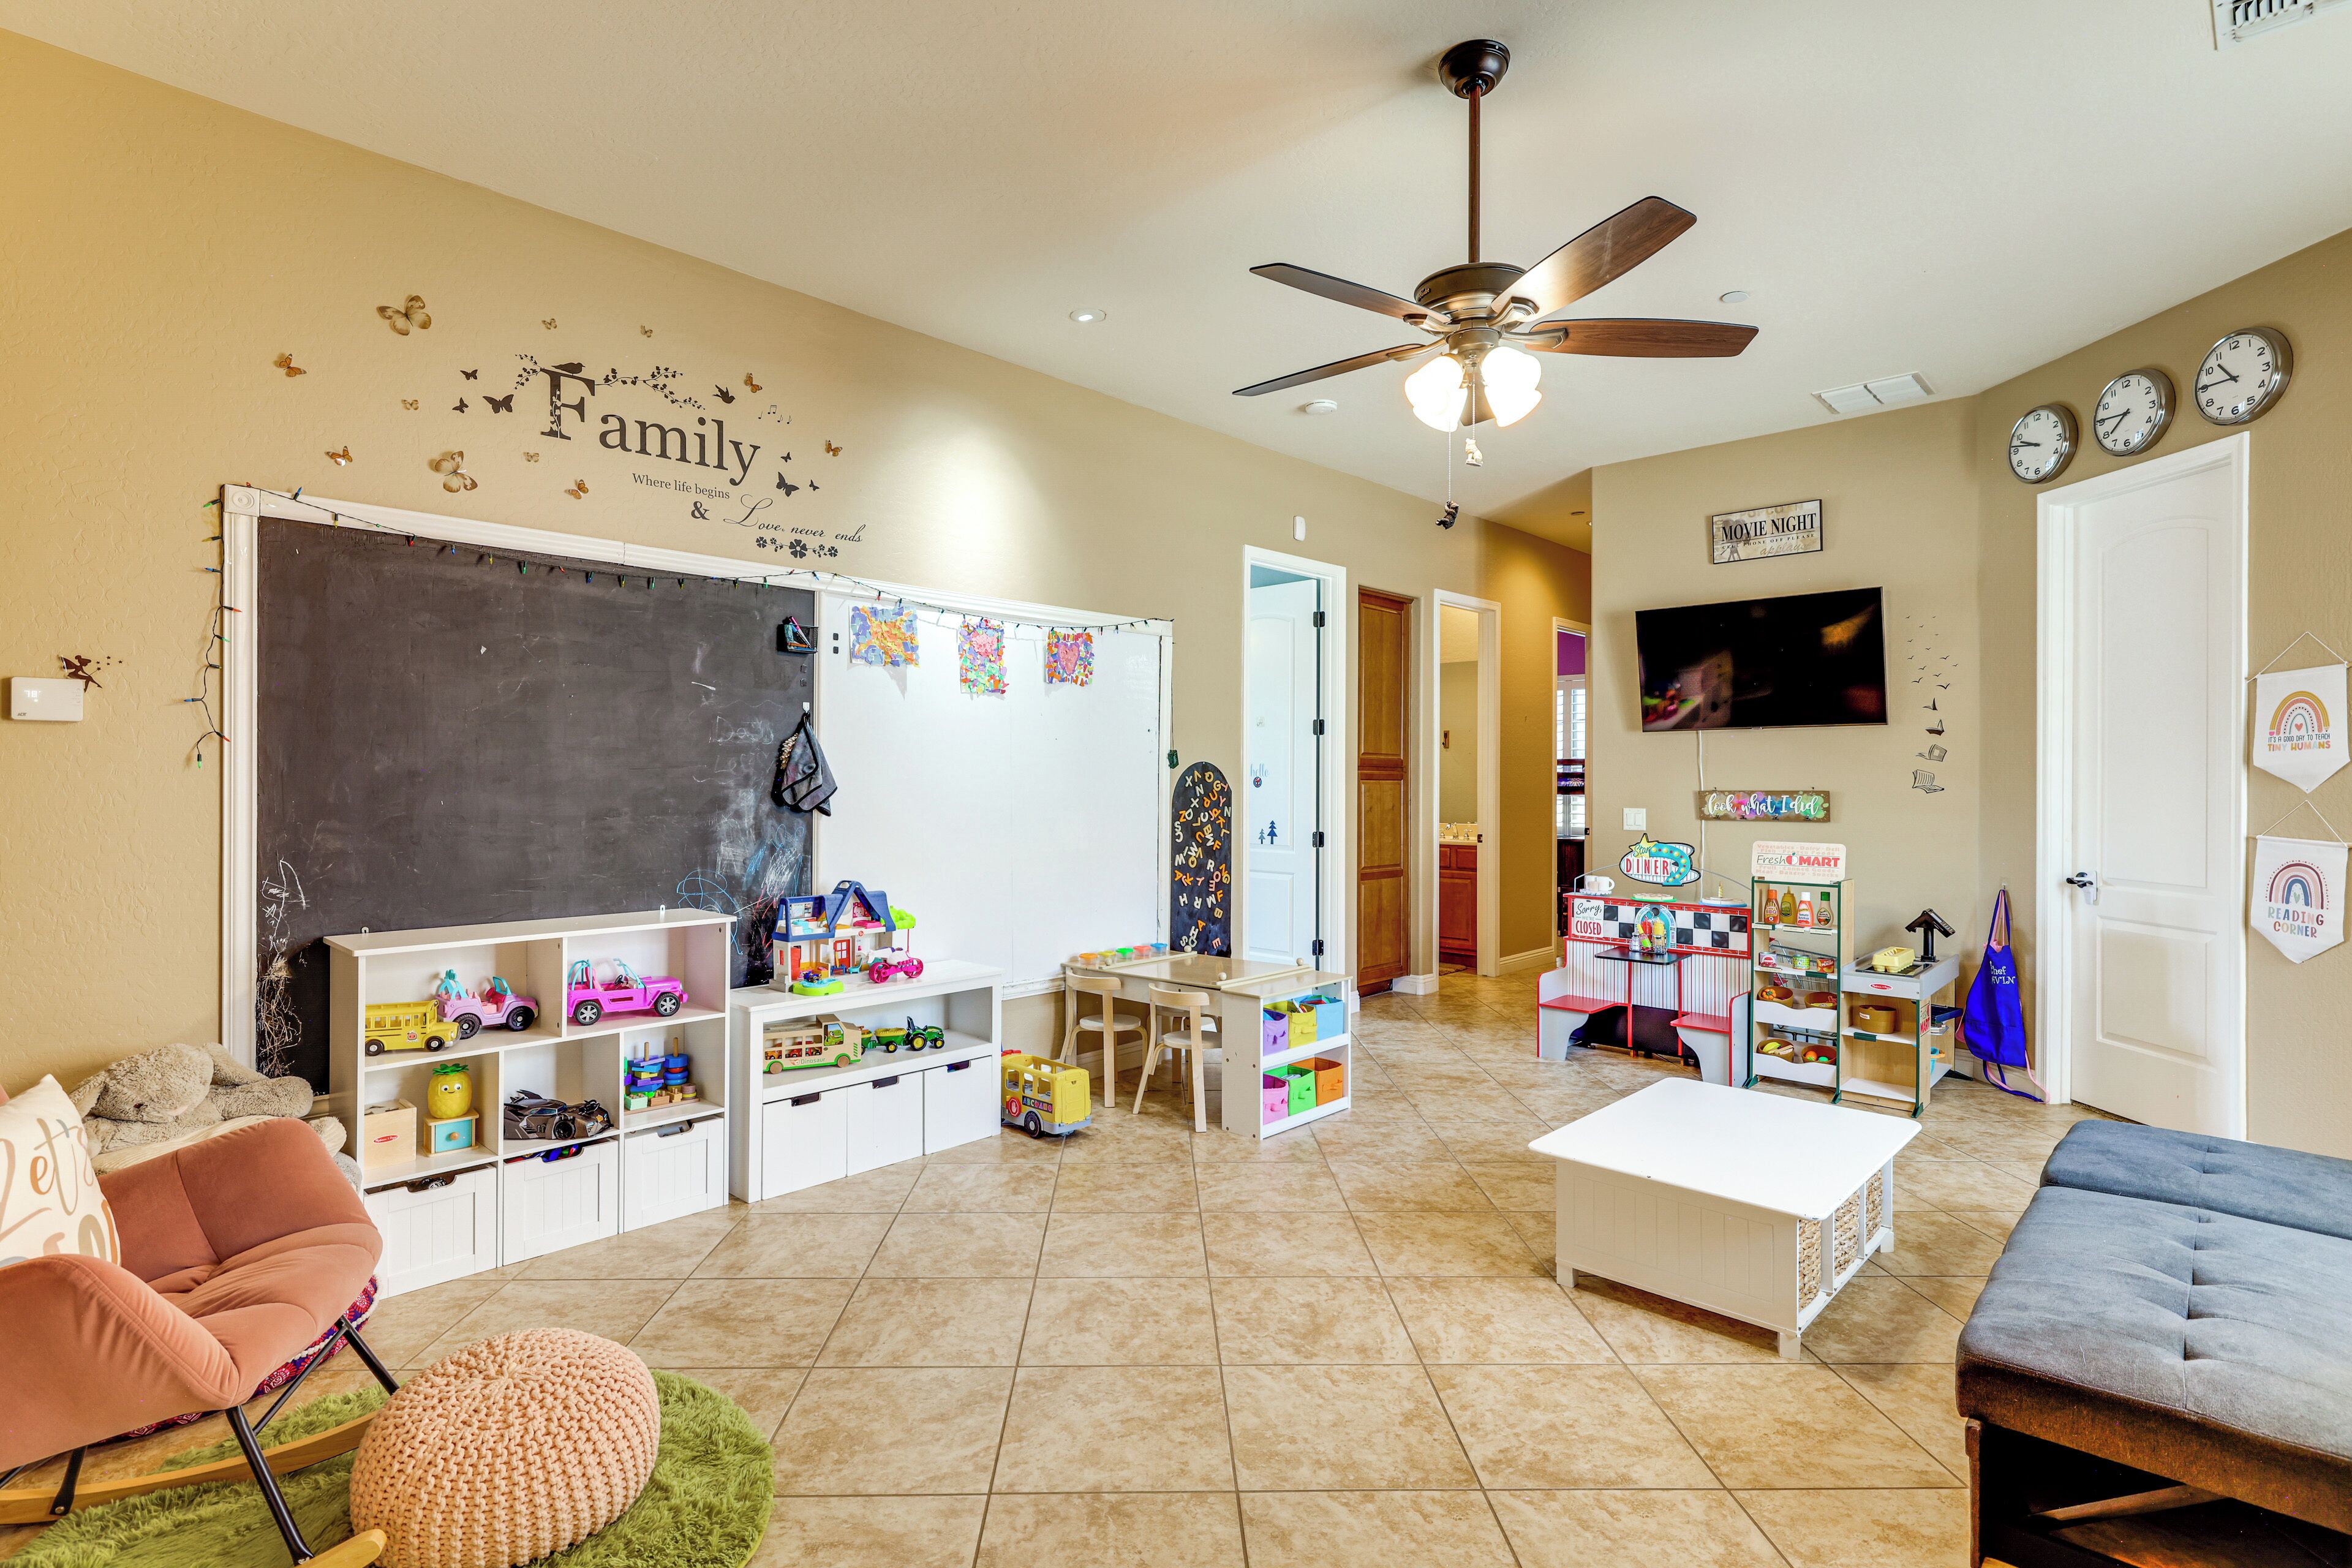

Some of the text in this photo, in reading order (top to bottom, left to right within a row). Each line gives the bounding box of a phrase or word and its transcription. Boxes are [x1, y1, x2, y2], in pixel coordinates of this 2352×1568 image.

[2230, 341, 2239, 350] 12
[2217, 352, 2222, 361] 11
[2257, 347, 2265, 356] 2
[2206, 367, 2214, 376] 10
[2262, 361, 2271, 372] 3
[2122, 380, 2130, 388] 12
[2258, 380, 2266, 388] 4
[2145, 386, 2152, 395] 2
[2149, 400, 2155, 409] 3
[2247, 396, 2255, 405] 5
[2217, 407, 2223, 415] 7
[2231, 406, 2239, 415] 6
[540, 368, 761, 486] Family
[632, 473, 730, 499] Where life begins
[691, 501, 710, 521] &
[791, 526, 826, 537] never
[835, 524, 865, 543] ends
[1722, 521, 1767, 541] MOVIE
[1771, 513, 1816, 535] NIGHT
[2291, 741, 2331, 751] HUMANS
[1251, 764, 1270, 777] hello
[1185, 775, 1193, 787] X
[1213, 780, 1221, 791] G
[1195, 784, 1204, 796] N
[1209, 790, 1218, 801] U
[1190, 797, 1199, 808] X
[1219, 796, 1226, 807] Y
[1708, 793, 1819, 816] look what I did
[1179, 810, 1186, 822] Z
[1185, 809, 1193, 820] D
[1224, 806, 1231, 817] N
[1174, 821, 1181, 832] S
[1203, 824, 1212, 835] B
[1213, 840, 1221, 850] F
[1633, 845, 1651, 858] Star
[1207, 859, 1215, 872] R
[1757, 855, 1840, 867] Fresh MART
[1626, 858, 1669, 876] DINER
[1174, 870, 1183, 881] A
[1213, 871, 1221, 882] O
[1208, 880, 1215, 891] E
[1179, 893, 1188, 906] H
[1216, 890, 1223, 902] F
[1194, 897, 1202, 909] R
[1214, 907, 1223, 918] B
[1576, 903, 1602, 916] Sorry,
[2267, 907, 2324, 925] READING
[1197, 920, 1205, 931] A
[1575, 921, 1602, 935] CLOSED
[2274, 921, 2316, 938] CORNER
[1189, 926, 1199, 939] H
[1180, 936, 1188, 947] S
[1212, 937, 1221, 949] E
[1920, 1017, 1930, 1035] MART
[1023, 1097, 1035, 1106] ABC
